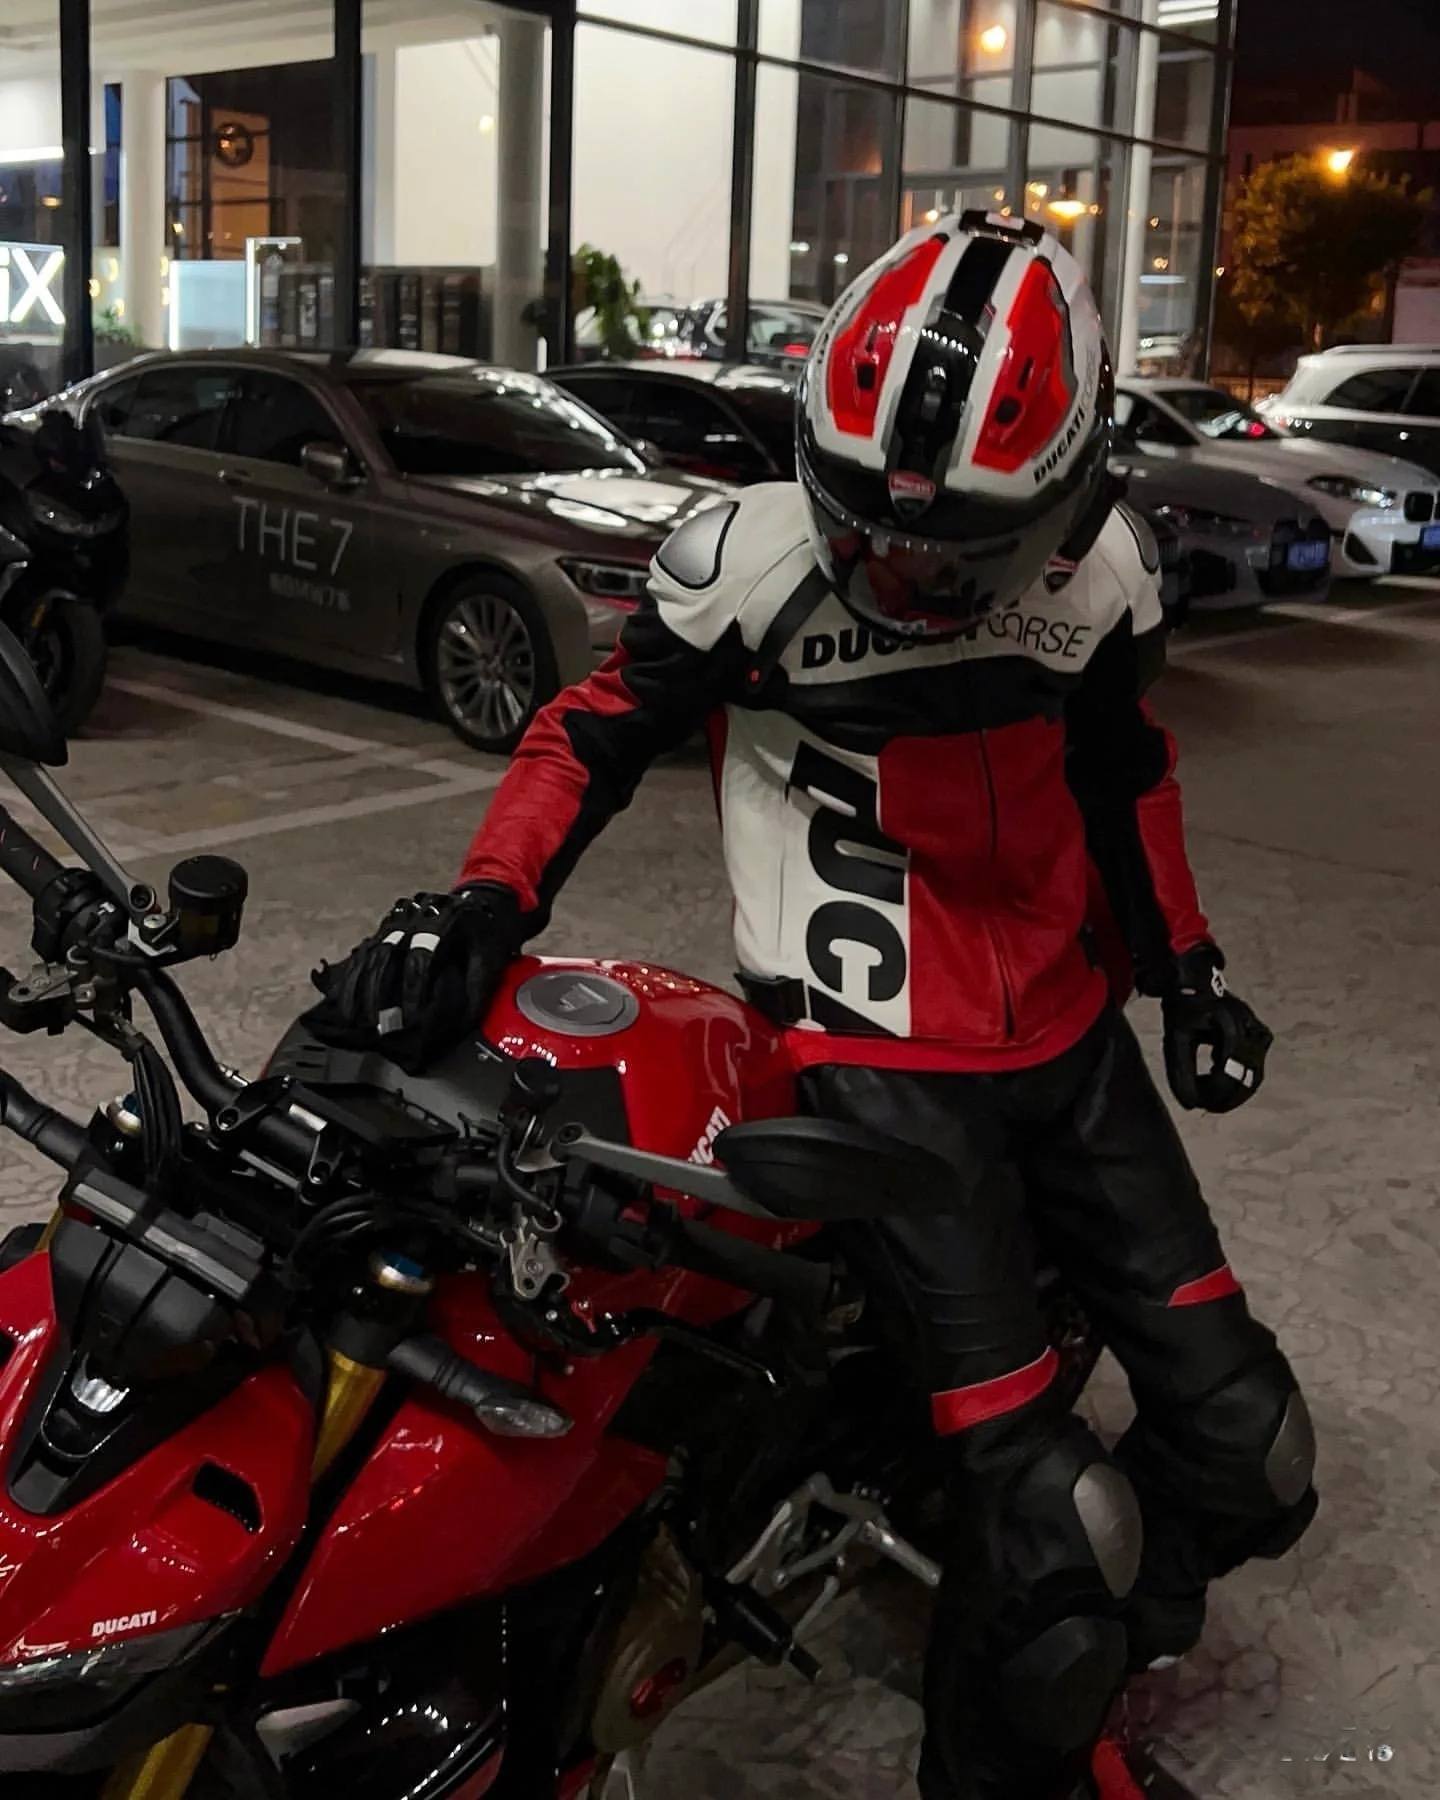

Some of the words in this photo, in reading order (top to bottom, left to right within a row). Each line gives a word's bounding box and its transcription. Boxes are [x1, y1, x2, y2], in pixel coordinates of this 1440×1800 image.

[1033, 406, 1085, 486] DUCATI
[231, 495, 319, 571] THE
[329, 517, 353, 577] 7
[91, 1609, 157, 1637] DUCATI
